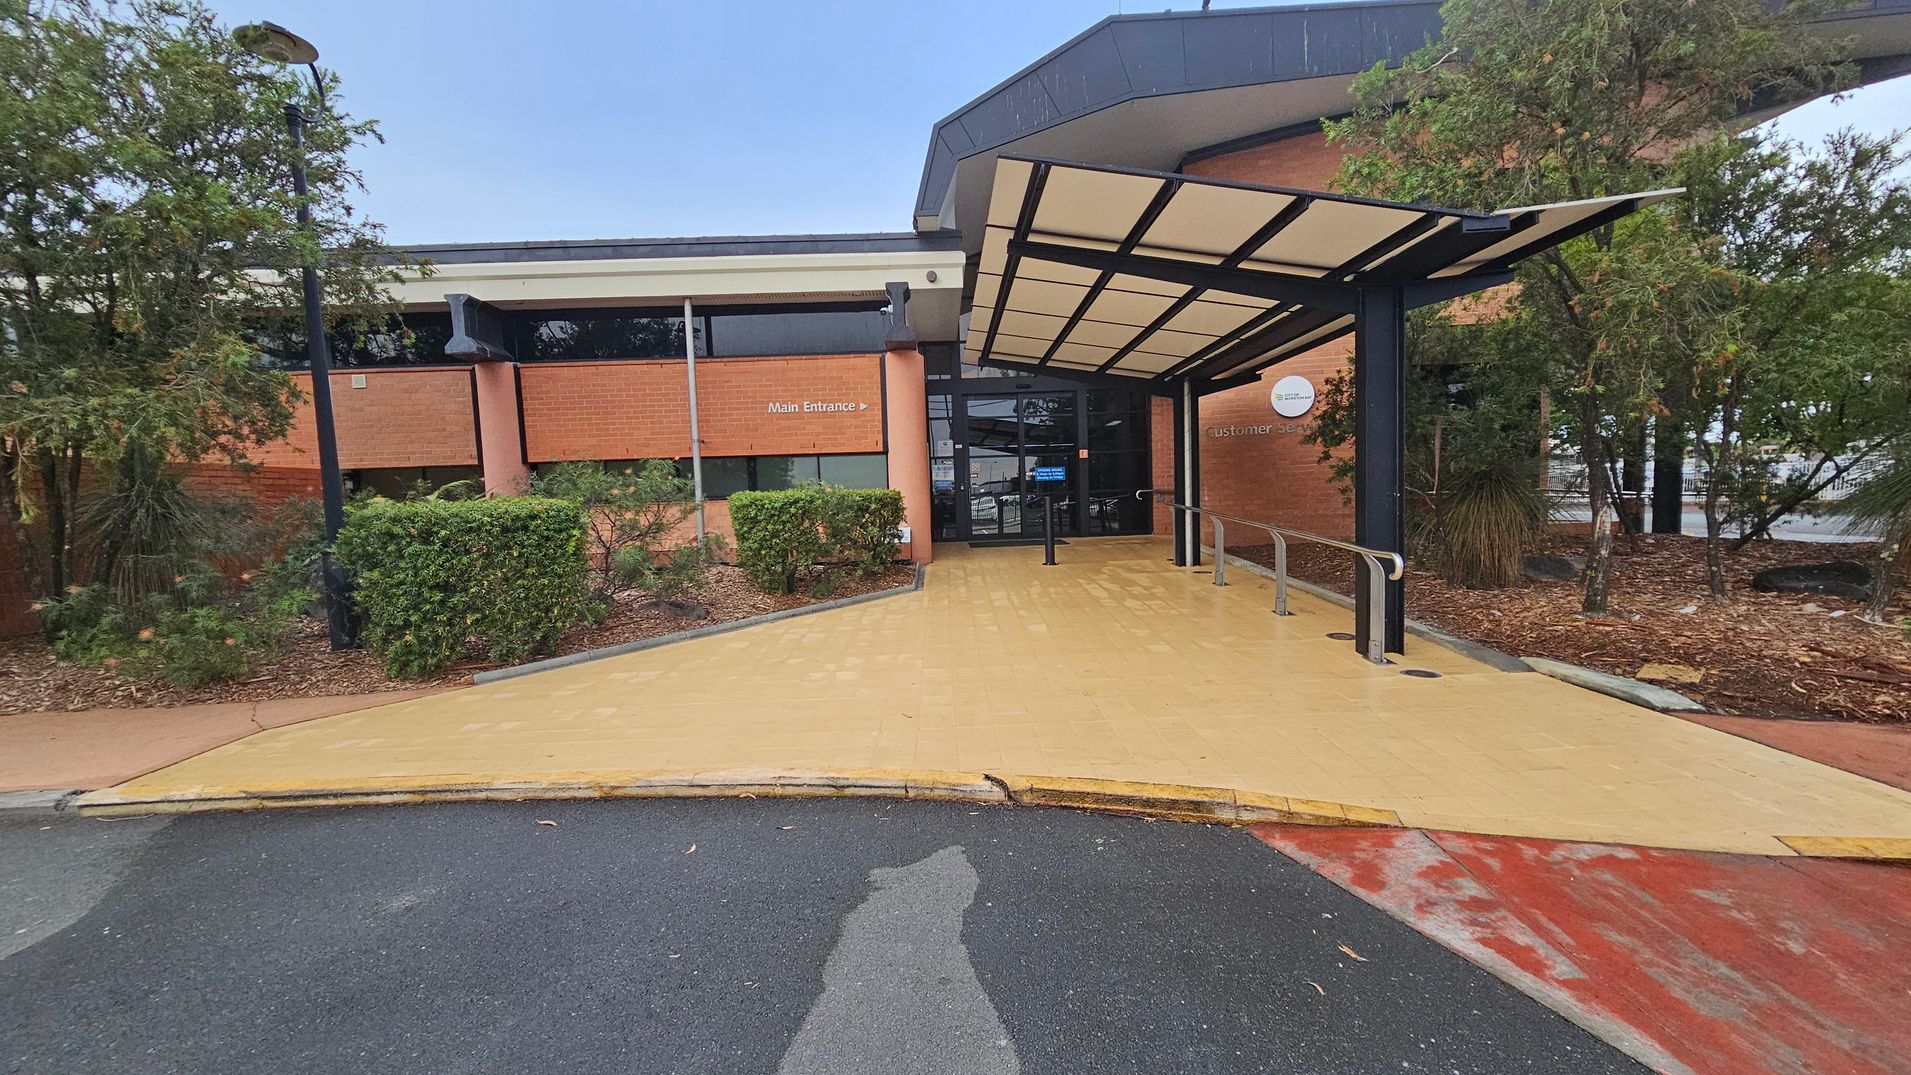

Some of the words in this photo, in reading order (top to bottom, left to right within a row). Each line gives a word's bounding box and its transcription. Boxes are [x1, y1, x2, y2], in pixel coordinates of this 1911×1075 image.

[768, 402, 799, 413] Main
[804, 401, 856, 412] Entrance
[1206, 425, 1272, 438] Customer
